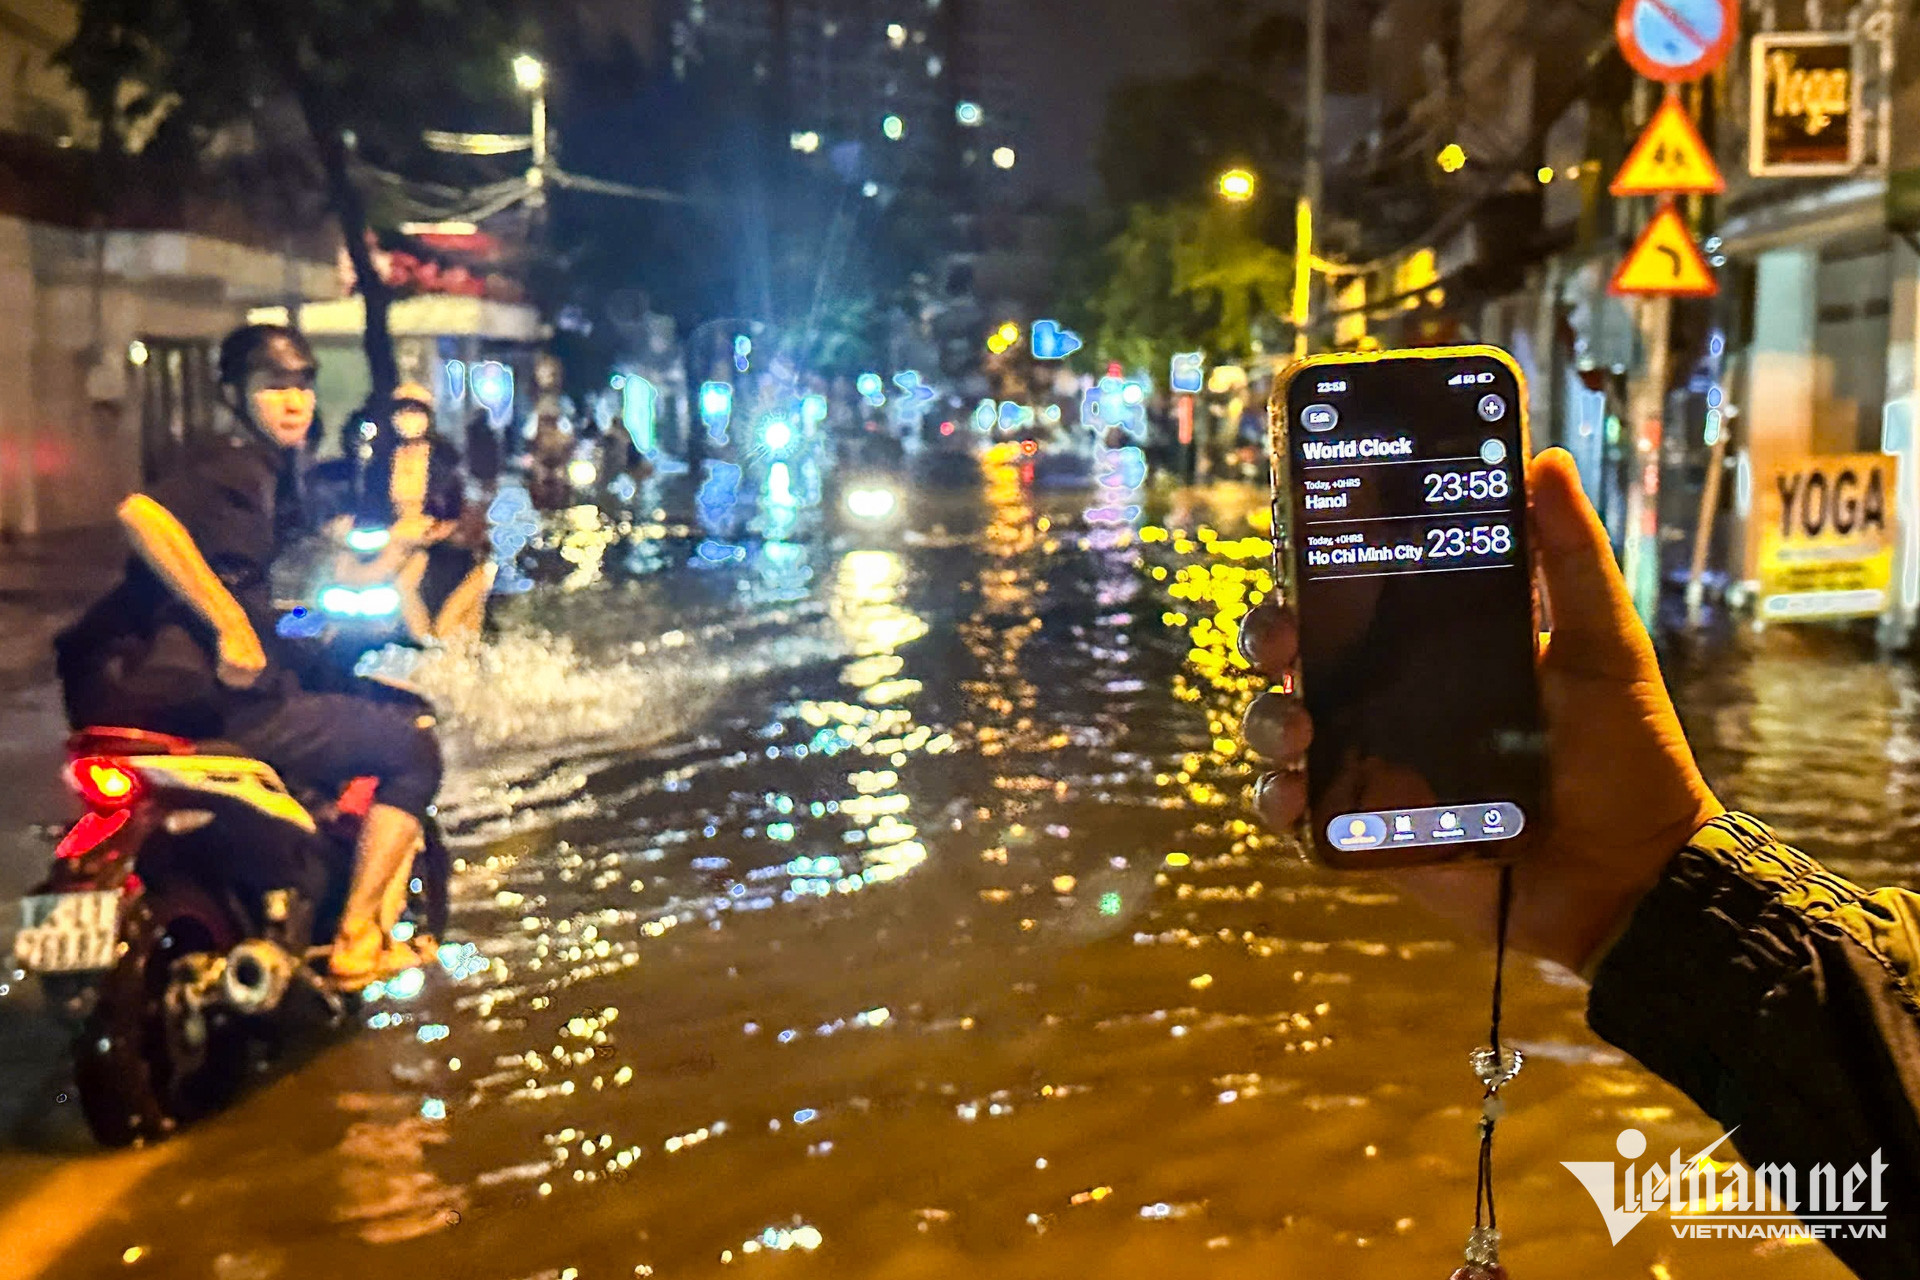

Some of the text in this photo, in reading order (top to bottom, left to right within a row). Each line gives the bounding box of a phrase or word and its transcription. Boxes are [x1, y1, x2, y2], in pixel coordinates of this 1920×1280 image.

[1303, 437, 1412, 460] World Clock
[1424, 469, 1508, 502] 23:58
[1305, 493, 1347, 509] Hanoi
[1776, 466, 1886, 538] YOGA
[1308, 544, 1423, 565] Ho Chi Minh City
[1427, 525, 1511, 557] 23:58
